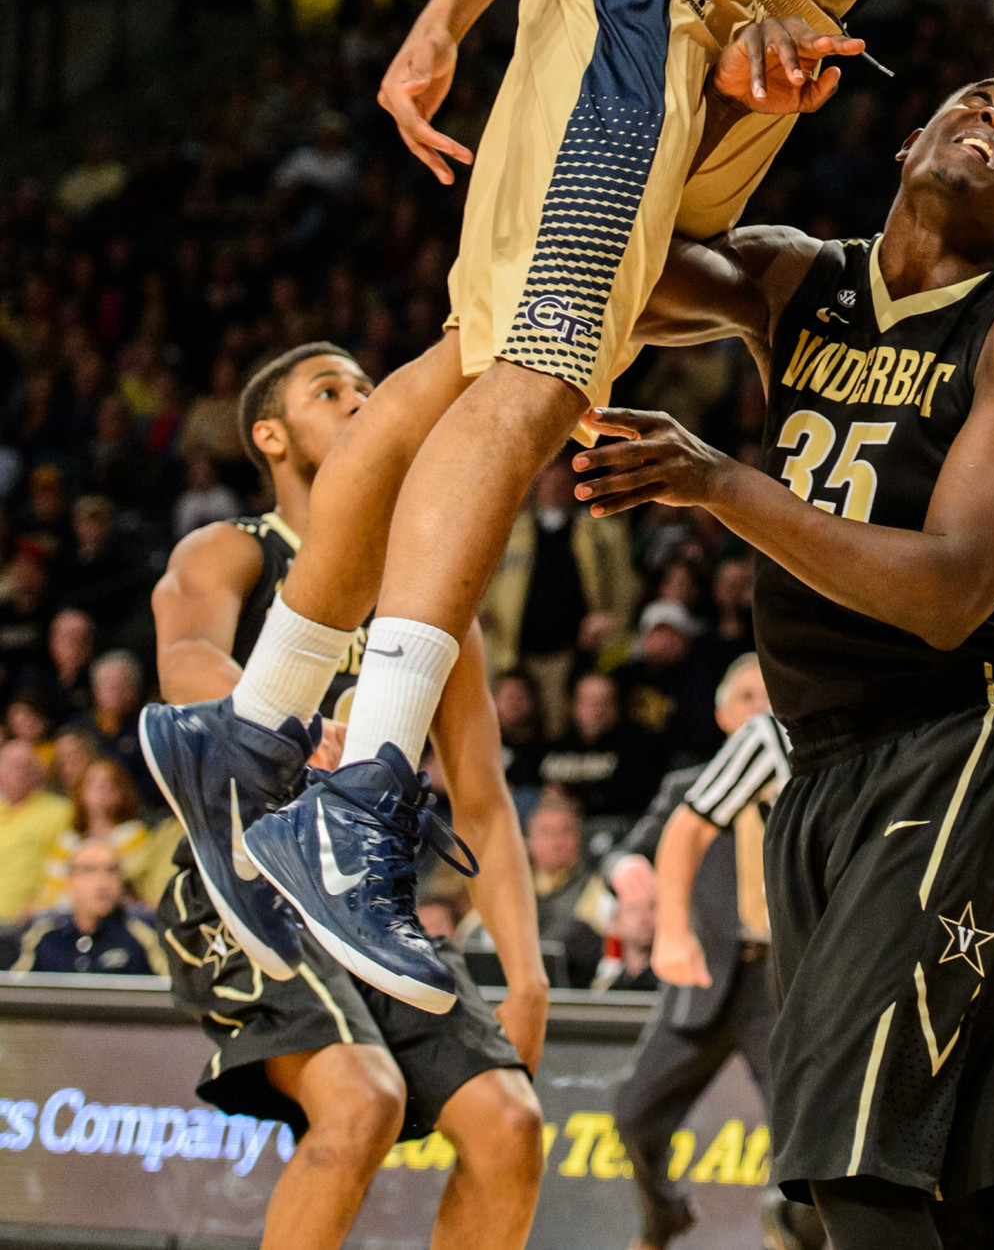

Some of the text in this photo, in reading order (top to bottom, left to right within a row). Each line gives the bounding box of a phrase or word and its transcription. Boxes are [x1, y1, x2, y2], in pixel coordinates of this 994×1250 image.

[525, 294, 594, 346] GT
[776, 410, 897, 523] 35
[957, 925, 975, 953] V
[39, 1087, 276, 1177] Company
